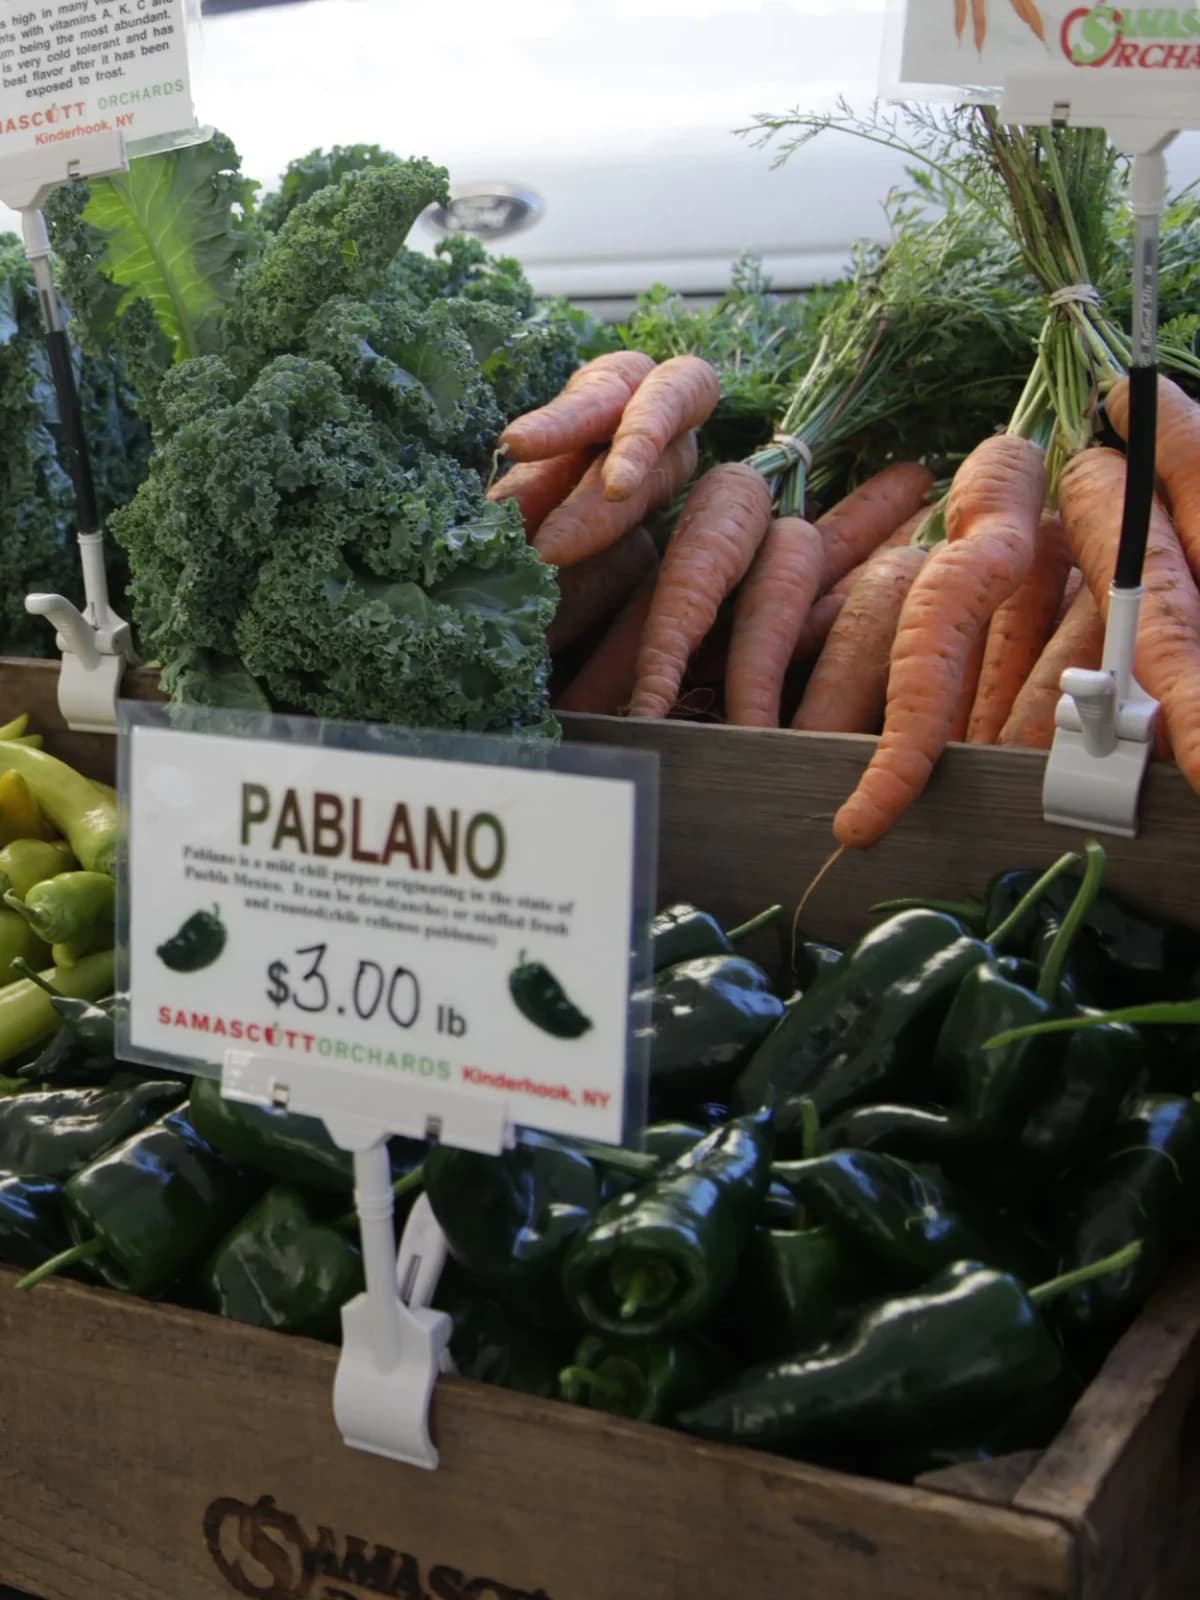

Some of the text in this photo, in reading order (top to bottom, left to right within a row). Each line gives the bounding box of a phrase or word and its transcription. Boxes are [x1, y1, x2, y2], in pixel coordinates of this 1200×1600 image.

[12, 12, 36, 26] high
[42, 8, 52, 19] in
[58, 0, 88, 14] many
[20, 39, 51, 54] being
[56, 34, 74, 45] the
[80, 24, 108, 39] most
[114, 9, 171, 32] abundant.
[21, 25, 44, 39] with
[49, 14, 97, 31] vitamins
[137, 0, 145, 10] C
[2, 62, 12, 73] is
[17, 57, 41, 70] very
[47, 48, 71, 63] cold
[76, 37, 120, 56] tolerant
[126, 29, 147, 44] and
[153, 25, 174, 38] has
[3, 74, 28, 88] best
[32, 67, 64, 81] flavor
[70, 59, 95, 73] after
[101, 54, 109, 65] it
[114, 50, 135, 62] has
[140, 41, 170, 56] been
[26, 66, 126, 98] exposed to frost.
[98, 79, 184, 110] ORCHARDS
[115, 112, 135, 128] NY
[239, 782, 507, 881] PABLANO
[265, 859, 295, 874] mild
[333, 870, 380, 888] pepper
[386, 878, 465, 902] originating
[471, 889, 484, 901] in
[490, 891, 511, 906] the
[517, 896, 552, 912] state
[557, 901, 575, 915] of
[266, 943, 467, 1038] $3.00 lb
[462, 1065, 577, 1105] Kinderhook,
[583, 1089, 611, 1109] NY
